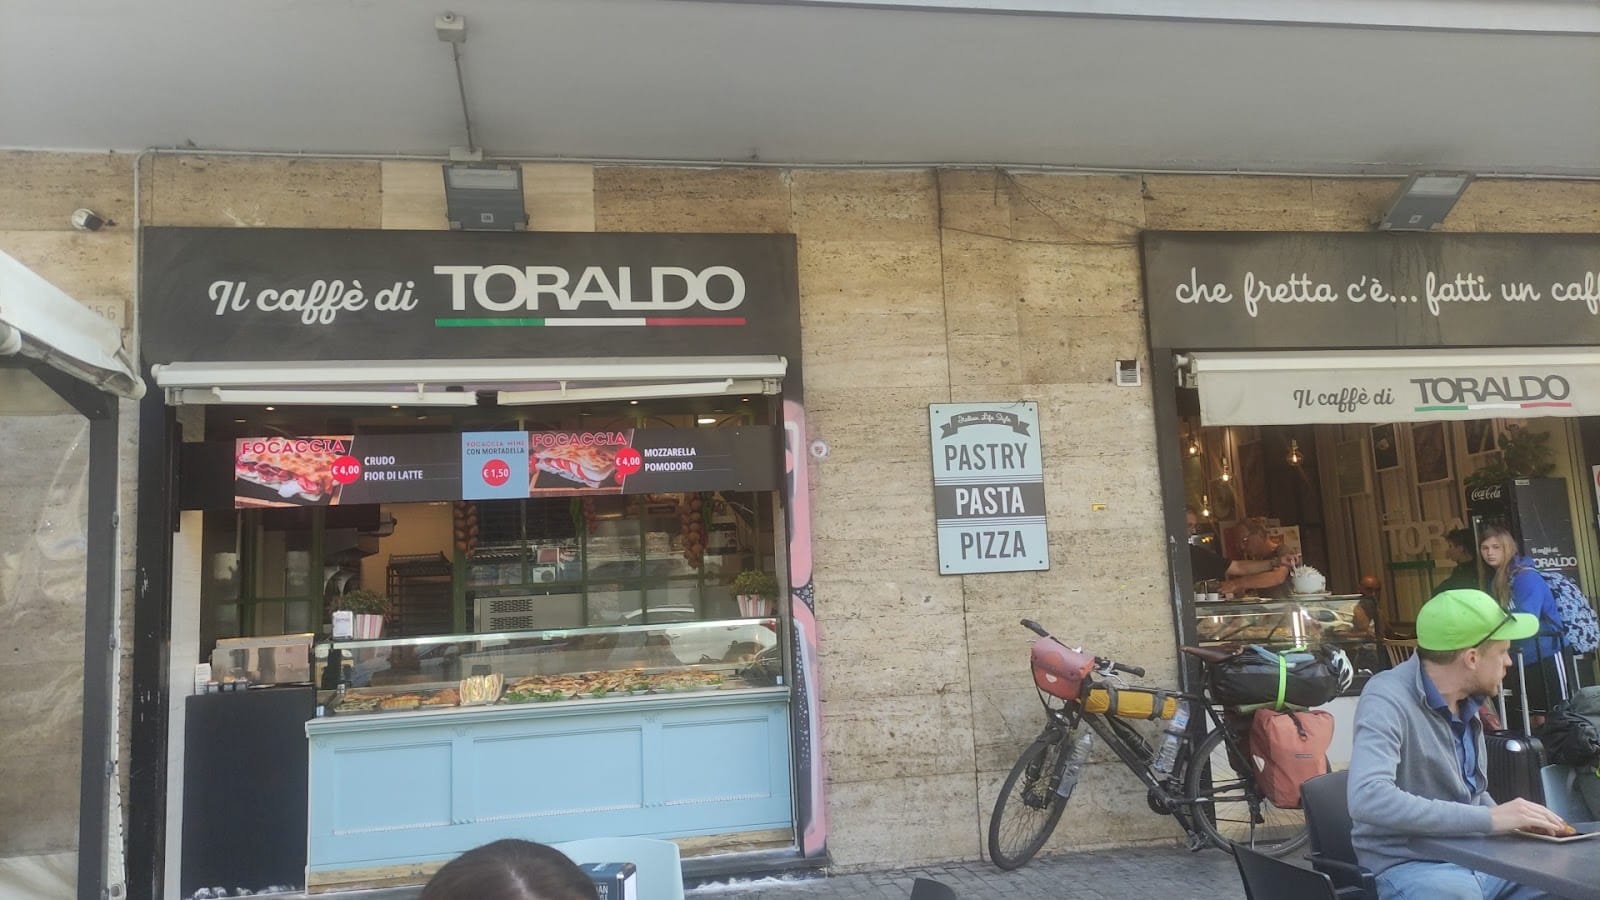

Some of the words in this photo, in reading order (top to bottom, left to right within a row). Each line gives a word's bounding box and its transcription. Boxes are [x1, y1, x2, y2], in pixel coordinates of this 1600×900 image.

[208, 281, 248, 316] Il
[256, 280, 369, 325] caffè
[374, 281, 418, 312] di
[434, 265, 746, 312] TORALDO
[1175, 267, 1233, 304] che
[1243, 271, 1338, 317] fretta
[1426, 271, 1491, 317] fatti
[1501, 281, 1541, 302] un
[1551, 271, 1600, 315] caf
[1293, 388, 1315, 409] Il
[1317, 386, 1372, 413] caffè
[1373, 386, 1395, 406] di
[1410, 374, 1570, 405] TORALDO
[242, 439, 345, 455] FOCACCIA
[531, 432, 628, 448] FOCACCIA
[482, 447, 525, 455] MORTADELLA
[644, 447, 696, 458] MOZZARELLA
[944, 442, 1028, 471] PASTRY
[364, 456, 395, 466] CRUDO
[644, 461, 694, 472] POMODORO
[364, 471, 385, 481] FIOR
[387, 471, 396, 480] DI
[397, 470, 424, 480] LATTE
[955, 486, 1025, 516] PASTA
[960, 530, 1027, 560] PIZZA
[1532, 556, 1577, 568] ORALDO
